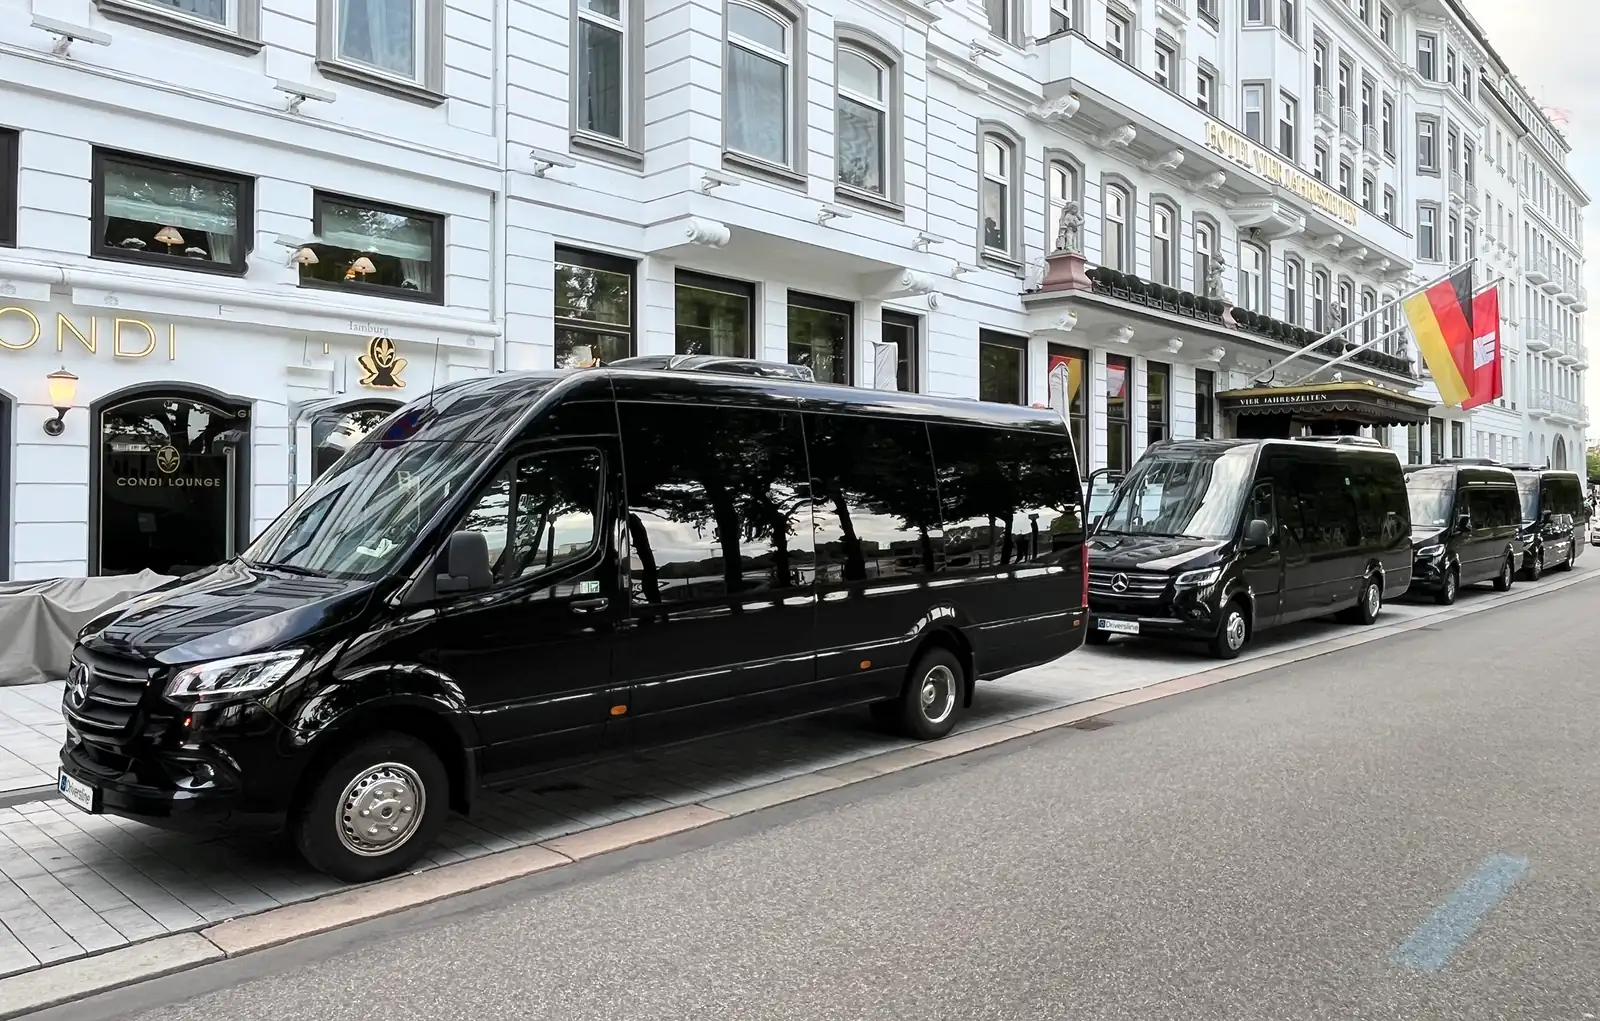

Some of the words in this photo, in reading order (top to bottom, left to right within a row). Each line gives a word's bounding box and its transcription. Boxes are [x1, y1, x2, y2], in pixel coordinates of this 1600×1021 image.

[1240, 398, 1259, 406] VIER
[116, 477, 162, 487] CONDI
[168, 478, 221, 488] LOUNGE
